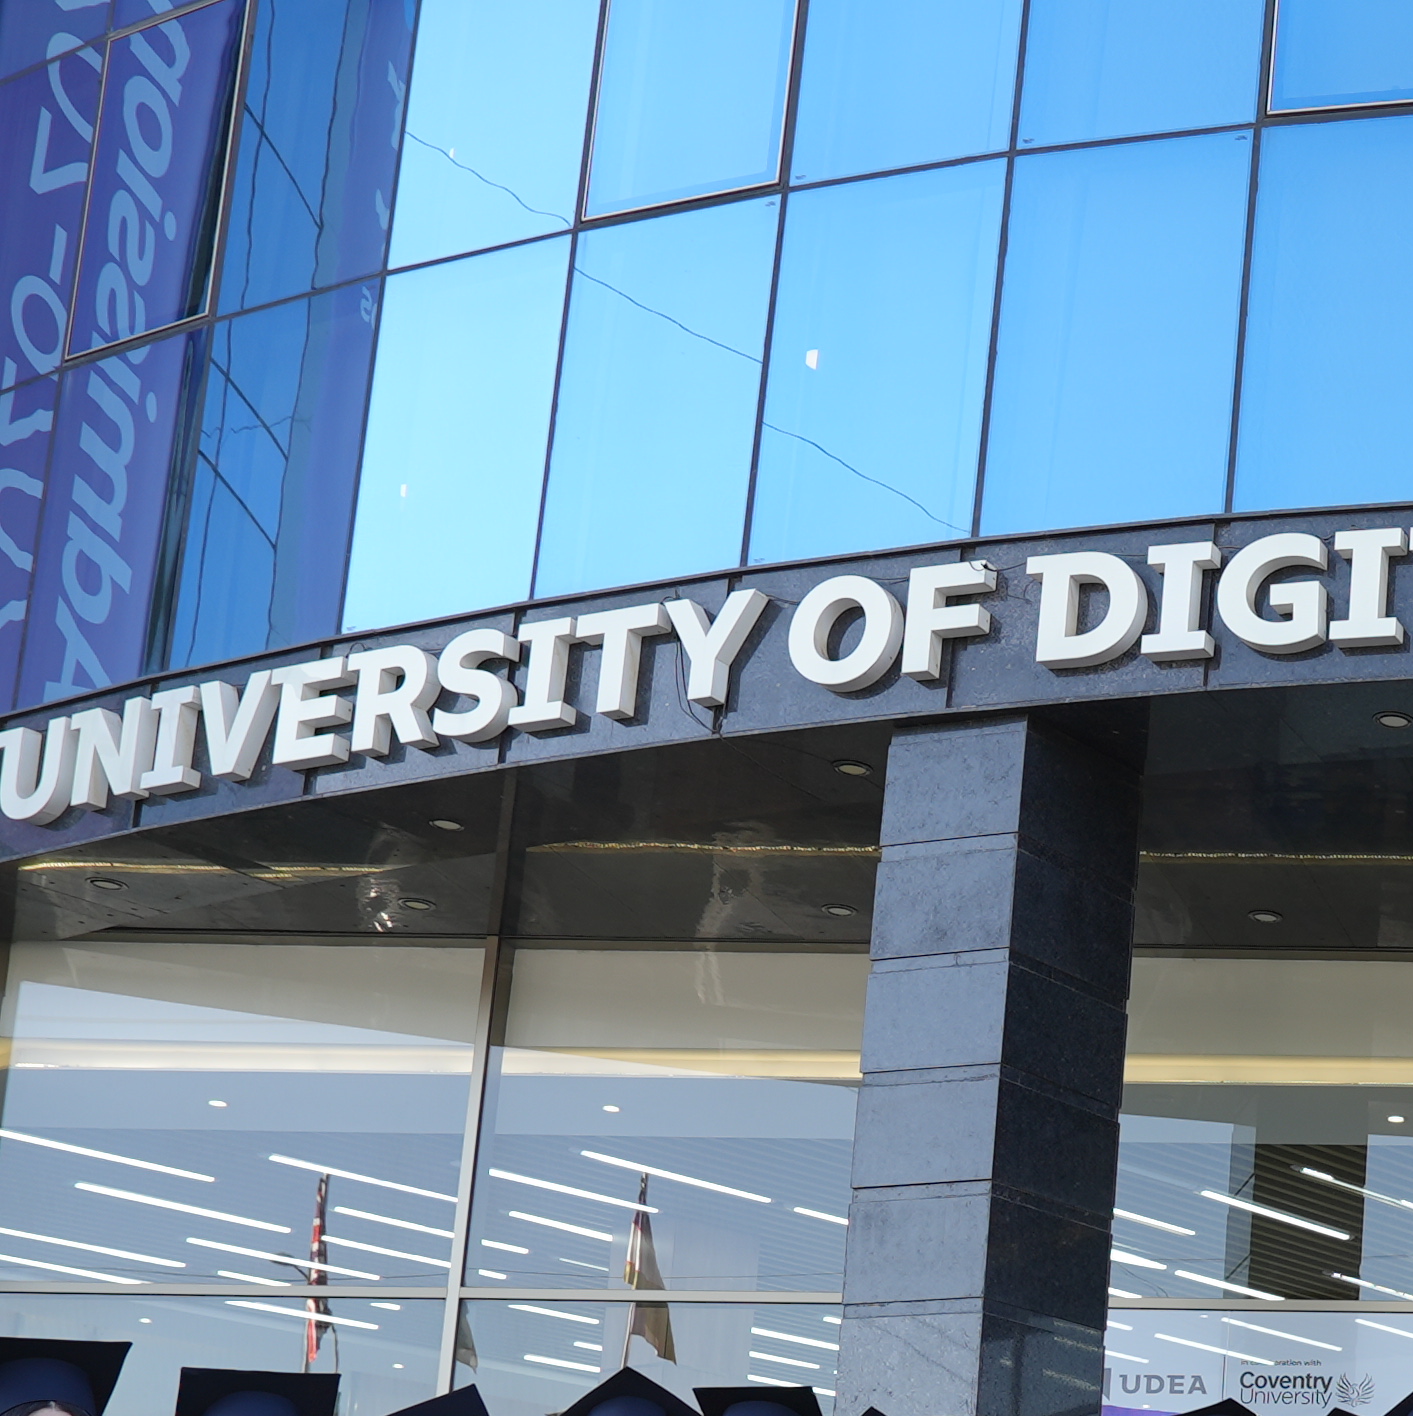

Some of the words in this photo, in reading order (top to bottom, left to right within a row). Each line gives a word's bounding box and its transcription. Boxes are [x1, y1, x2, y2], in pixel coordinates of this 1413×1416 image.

[0, 589, 769, 825] UNIVERSITY
[788, 560, 998, 693] OF
[1119, 1374, 1208, 1395] UDEA
[1240, 1371, 1334, 1394] Coventry
[1240, 1387, 1333, 1409] University
